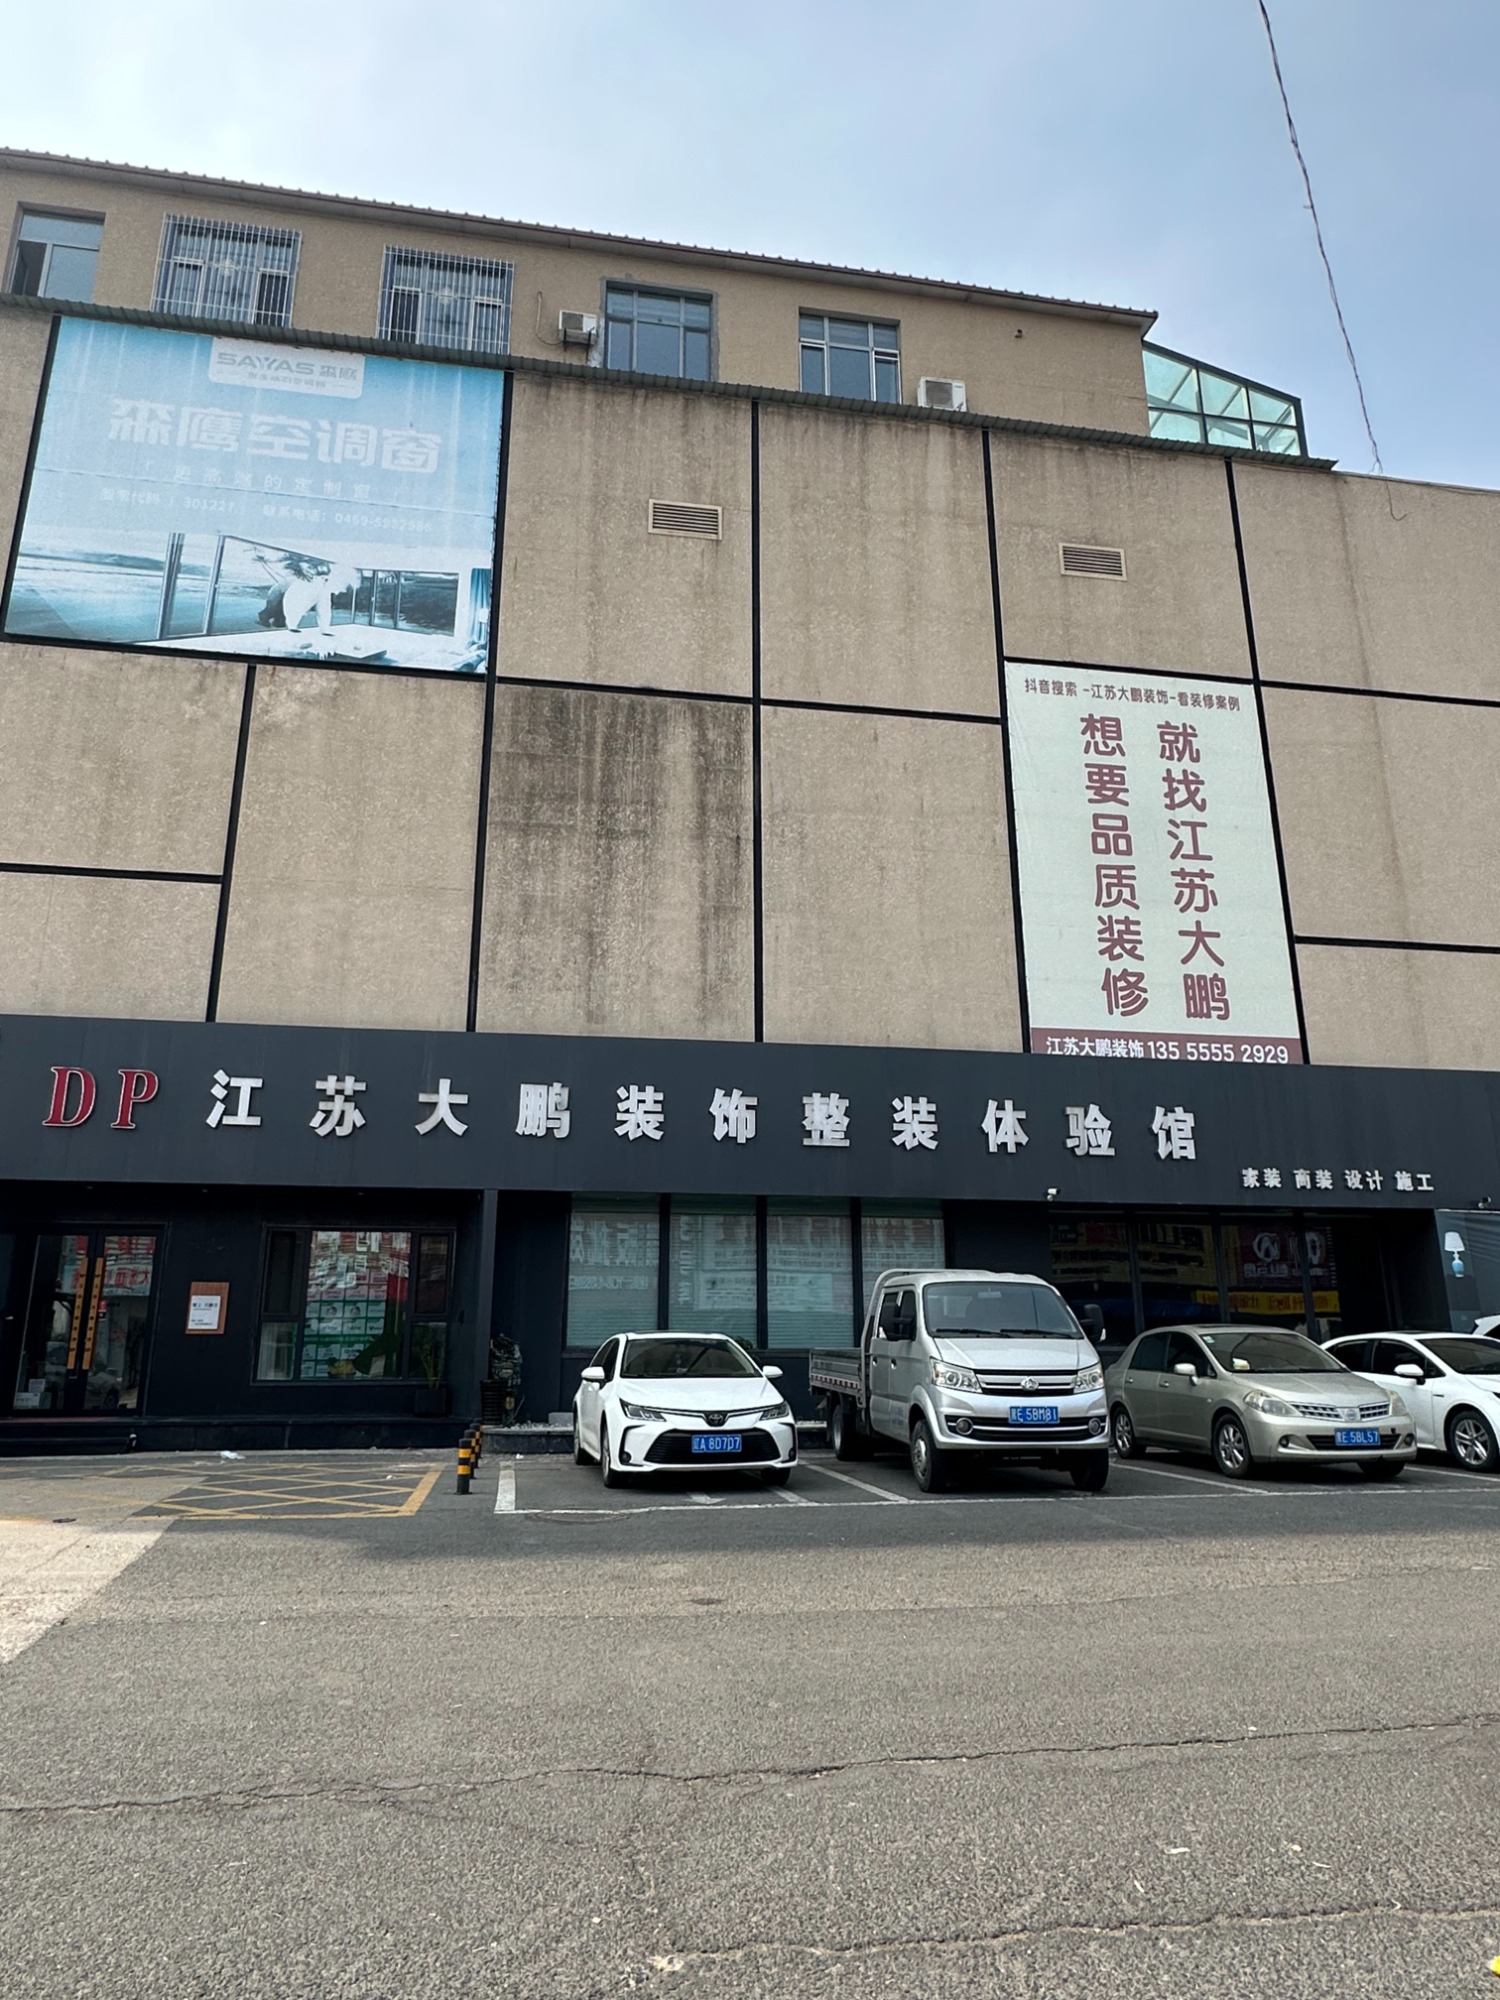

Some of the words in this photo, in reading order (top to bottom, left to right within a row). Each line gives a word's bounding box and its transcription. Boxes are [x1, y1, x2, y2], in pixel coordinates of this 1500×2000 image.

[1079, 713, 1150, 1017] 想要品质装修
[1157, 720, 1230, 1021] 就找江苏大鹏
[1046, 1036, 1144, 1059] 江苏大鹏装饰
[1240, 1044, 1289, 1064] 2929
[1242, 1167, 1282, 1189] 家装
[1293, 1168, 1334, 1190] 商装
[1344, 1169, 1384, 1191] 设计
[1395, 1170, 1434, 1191] 施工
